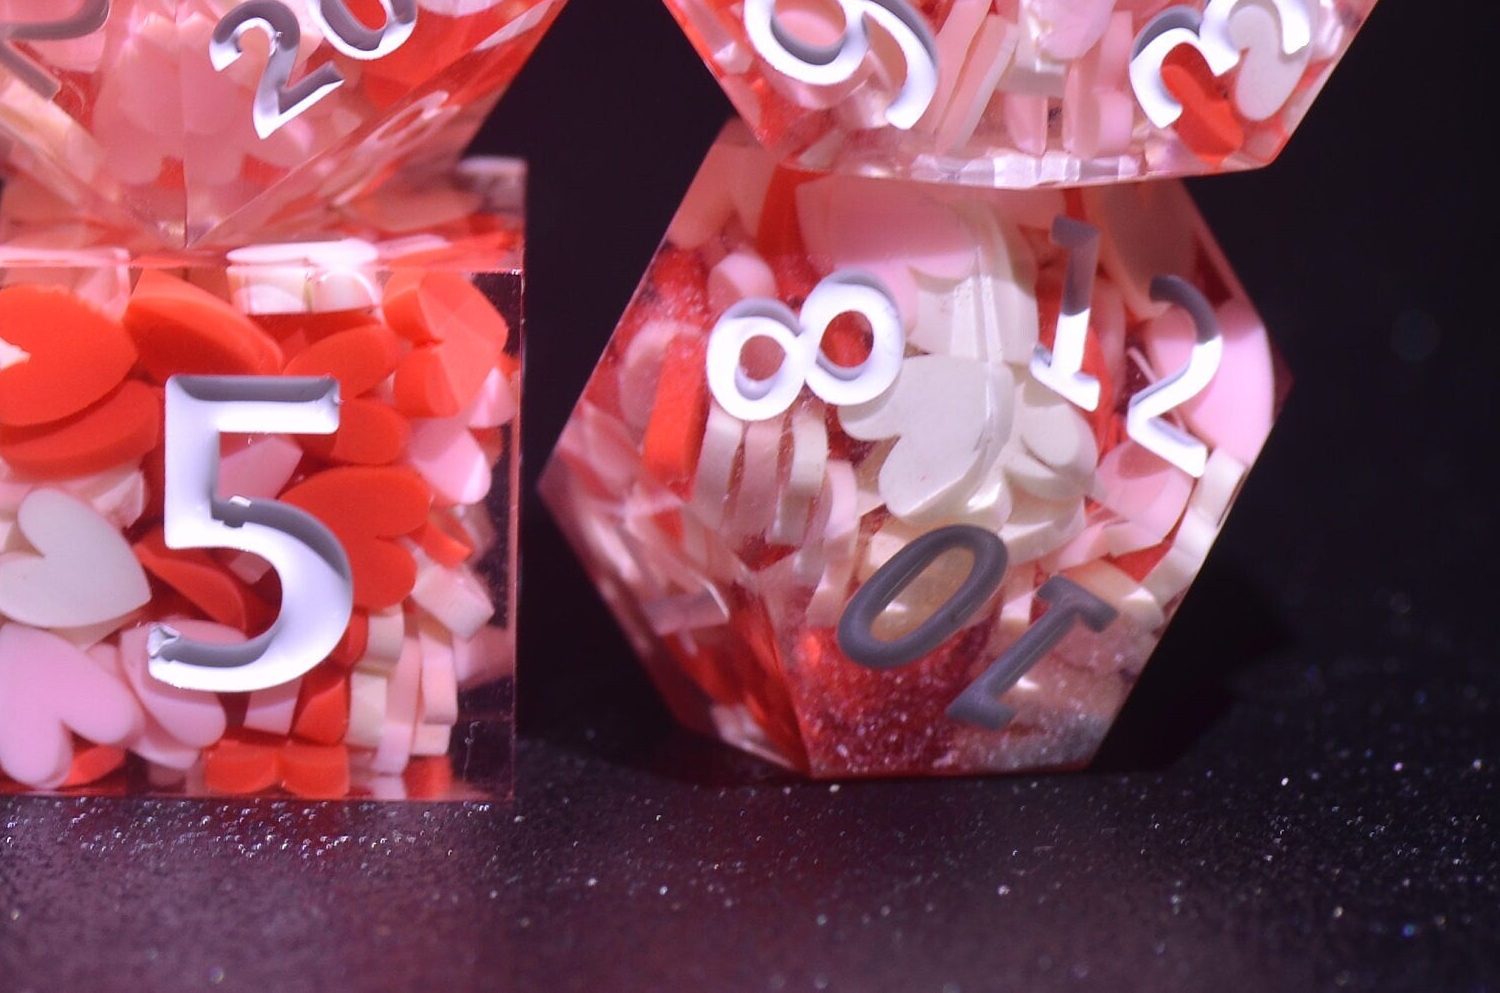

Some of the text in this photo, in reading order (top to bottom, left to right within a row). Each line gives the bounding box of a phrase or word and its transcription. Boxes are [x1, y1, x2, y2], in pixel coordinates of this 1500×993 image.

[707, 268, 902, 421] 8
[1031, 215, 1223, 477] 12
[148, 374, 353, 692] 5
[837, 524, 1117, 729] 10
